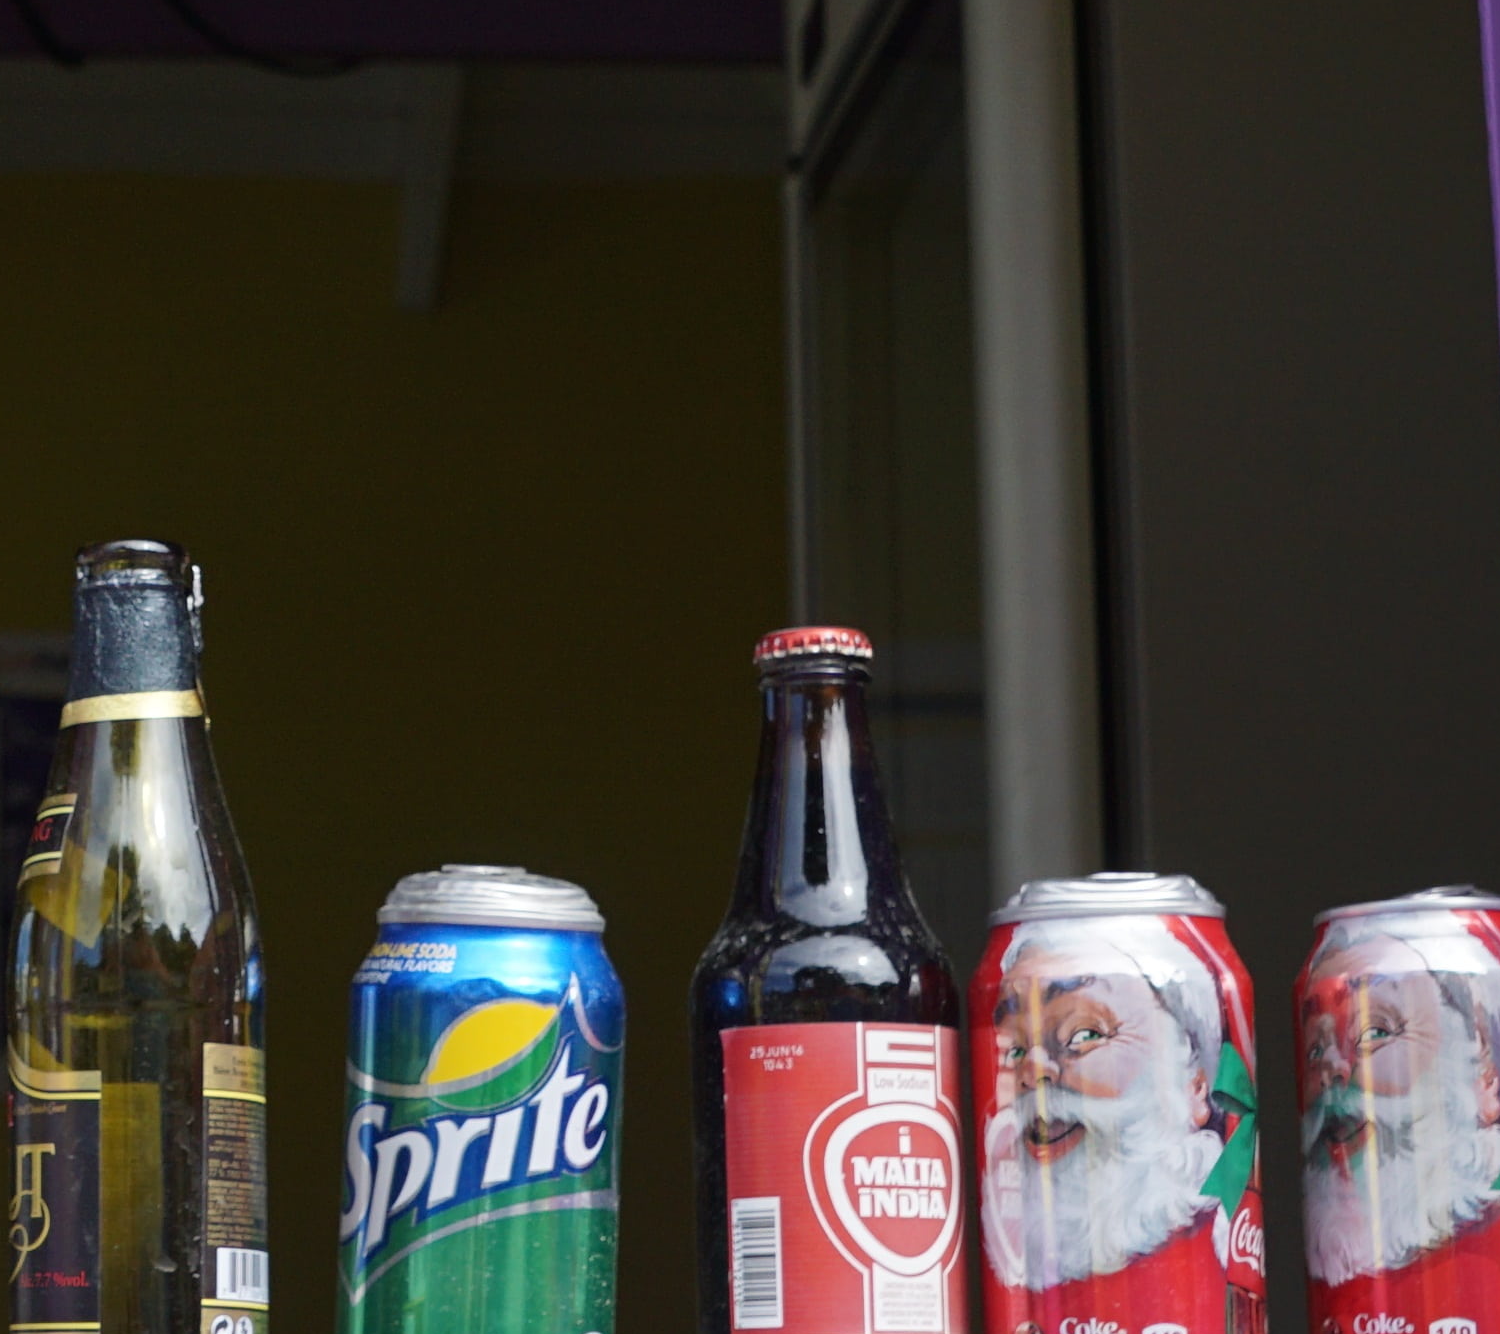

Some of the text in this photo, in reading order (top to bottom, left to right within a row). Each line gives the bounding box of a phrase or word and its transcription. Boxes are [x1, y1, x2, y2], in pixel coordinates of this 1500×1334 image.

[873, 1072, 931, 1090] Low Sodium
[340, 1044, 608, 1257] Sprite
[851, 1156, 946, 1187] MALTA
